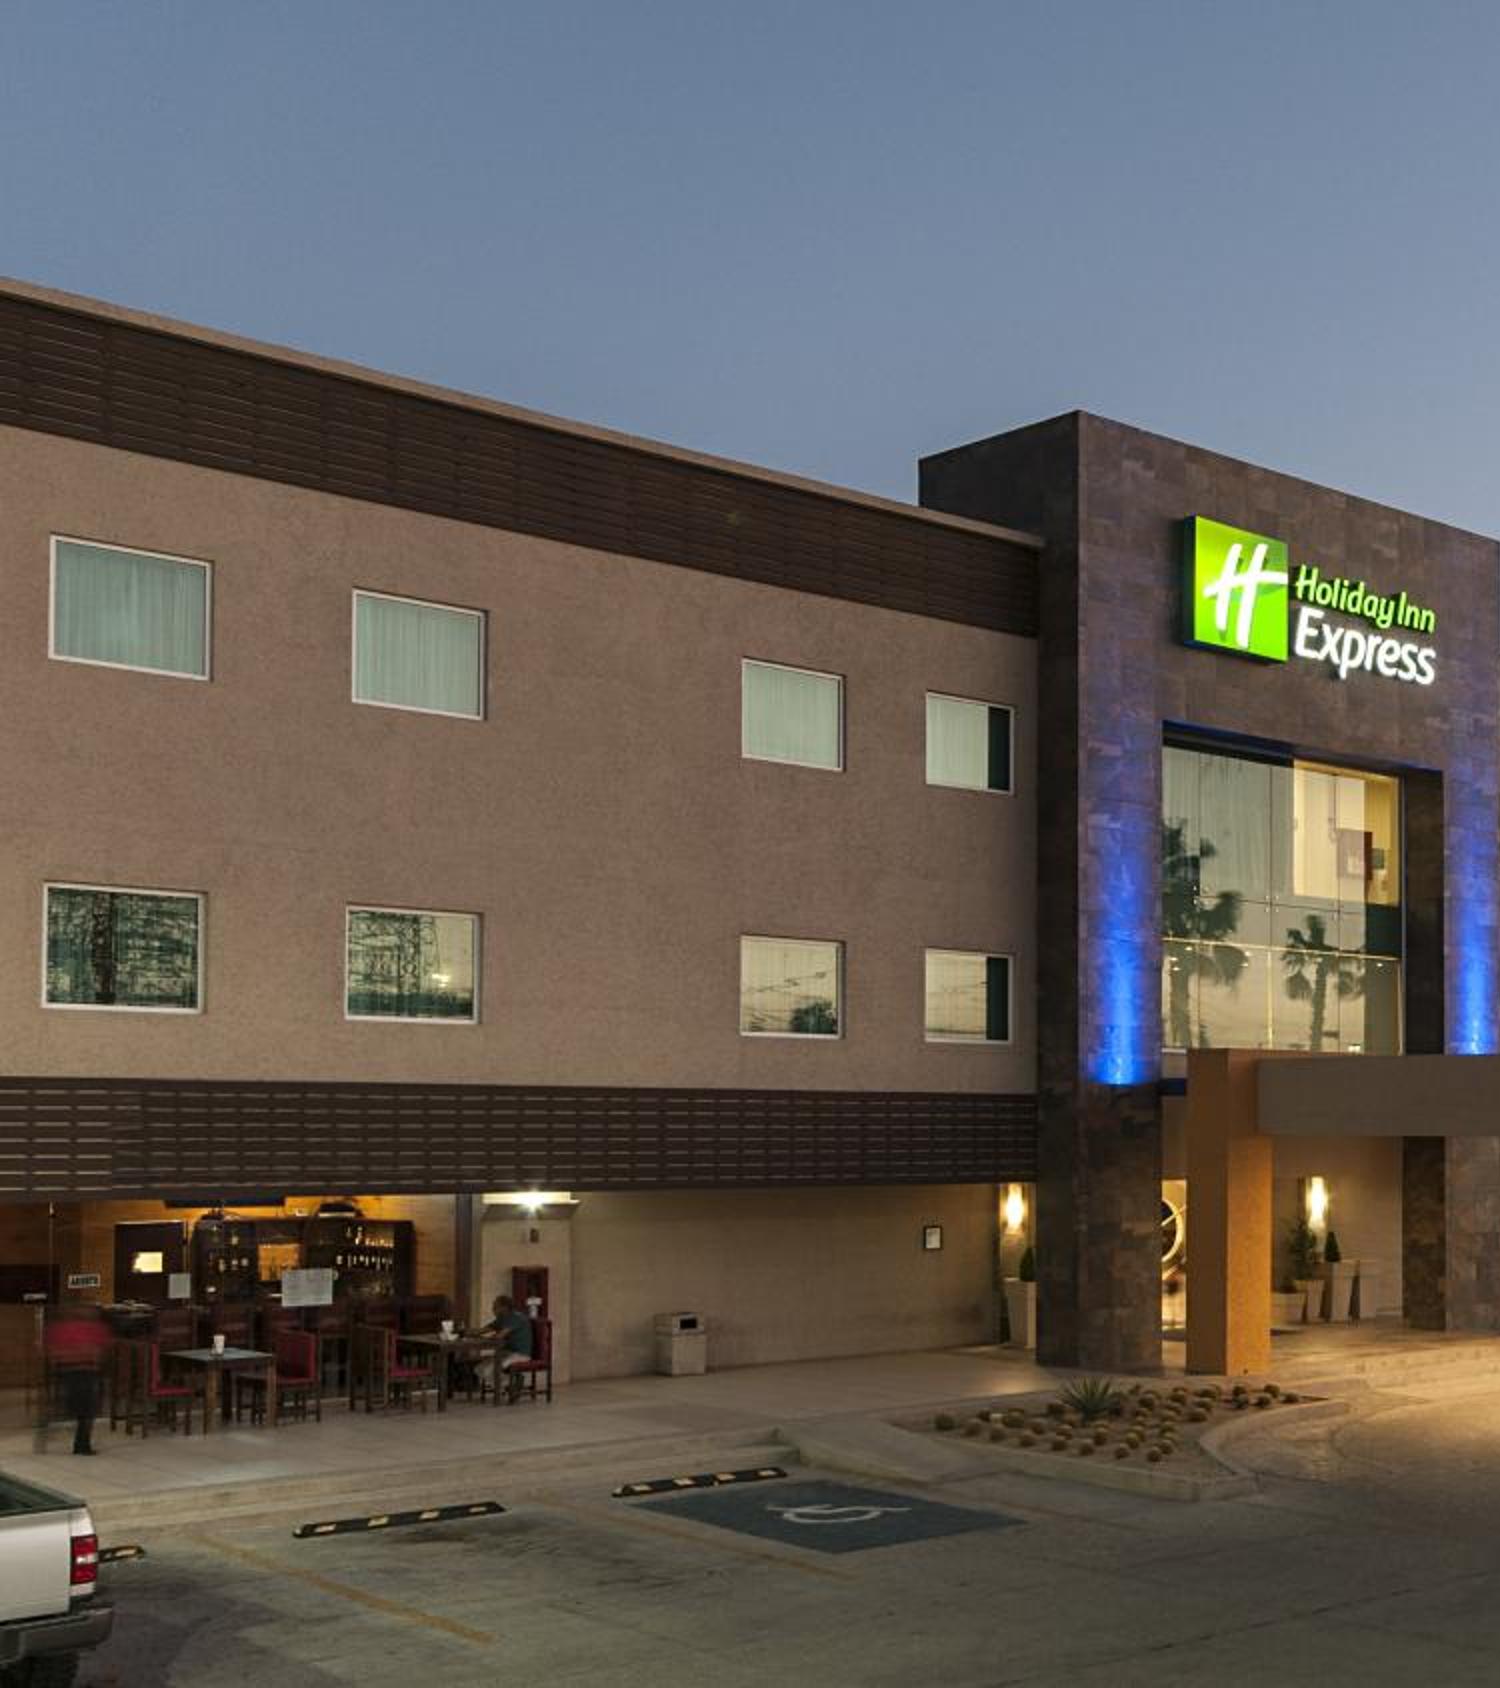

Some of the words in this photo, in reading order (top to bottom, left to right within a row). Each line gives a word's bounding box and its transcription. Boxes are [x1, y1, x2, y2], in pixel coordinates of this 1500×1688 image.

[1295, 564, 1394, 630] Holiday
[1398, 591, 1436, 634] Inn
[1294, 606, 1437, 685] Express
